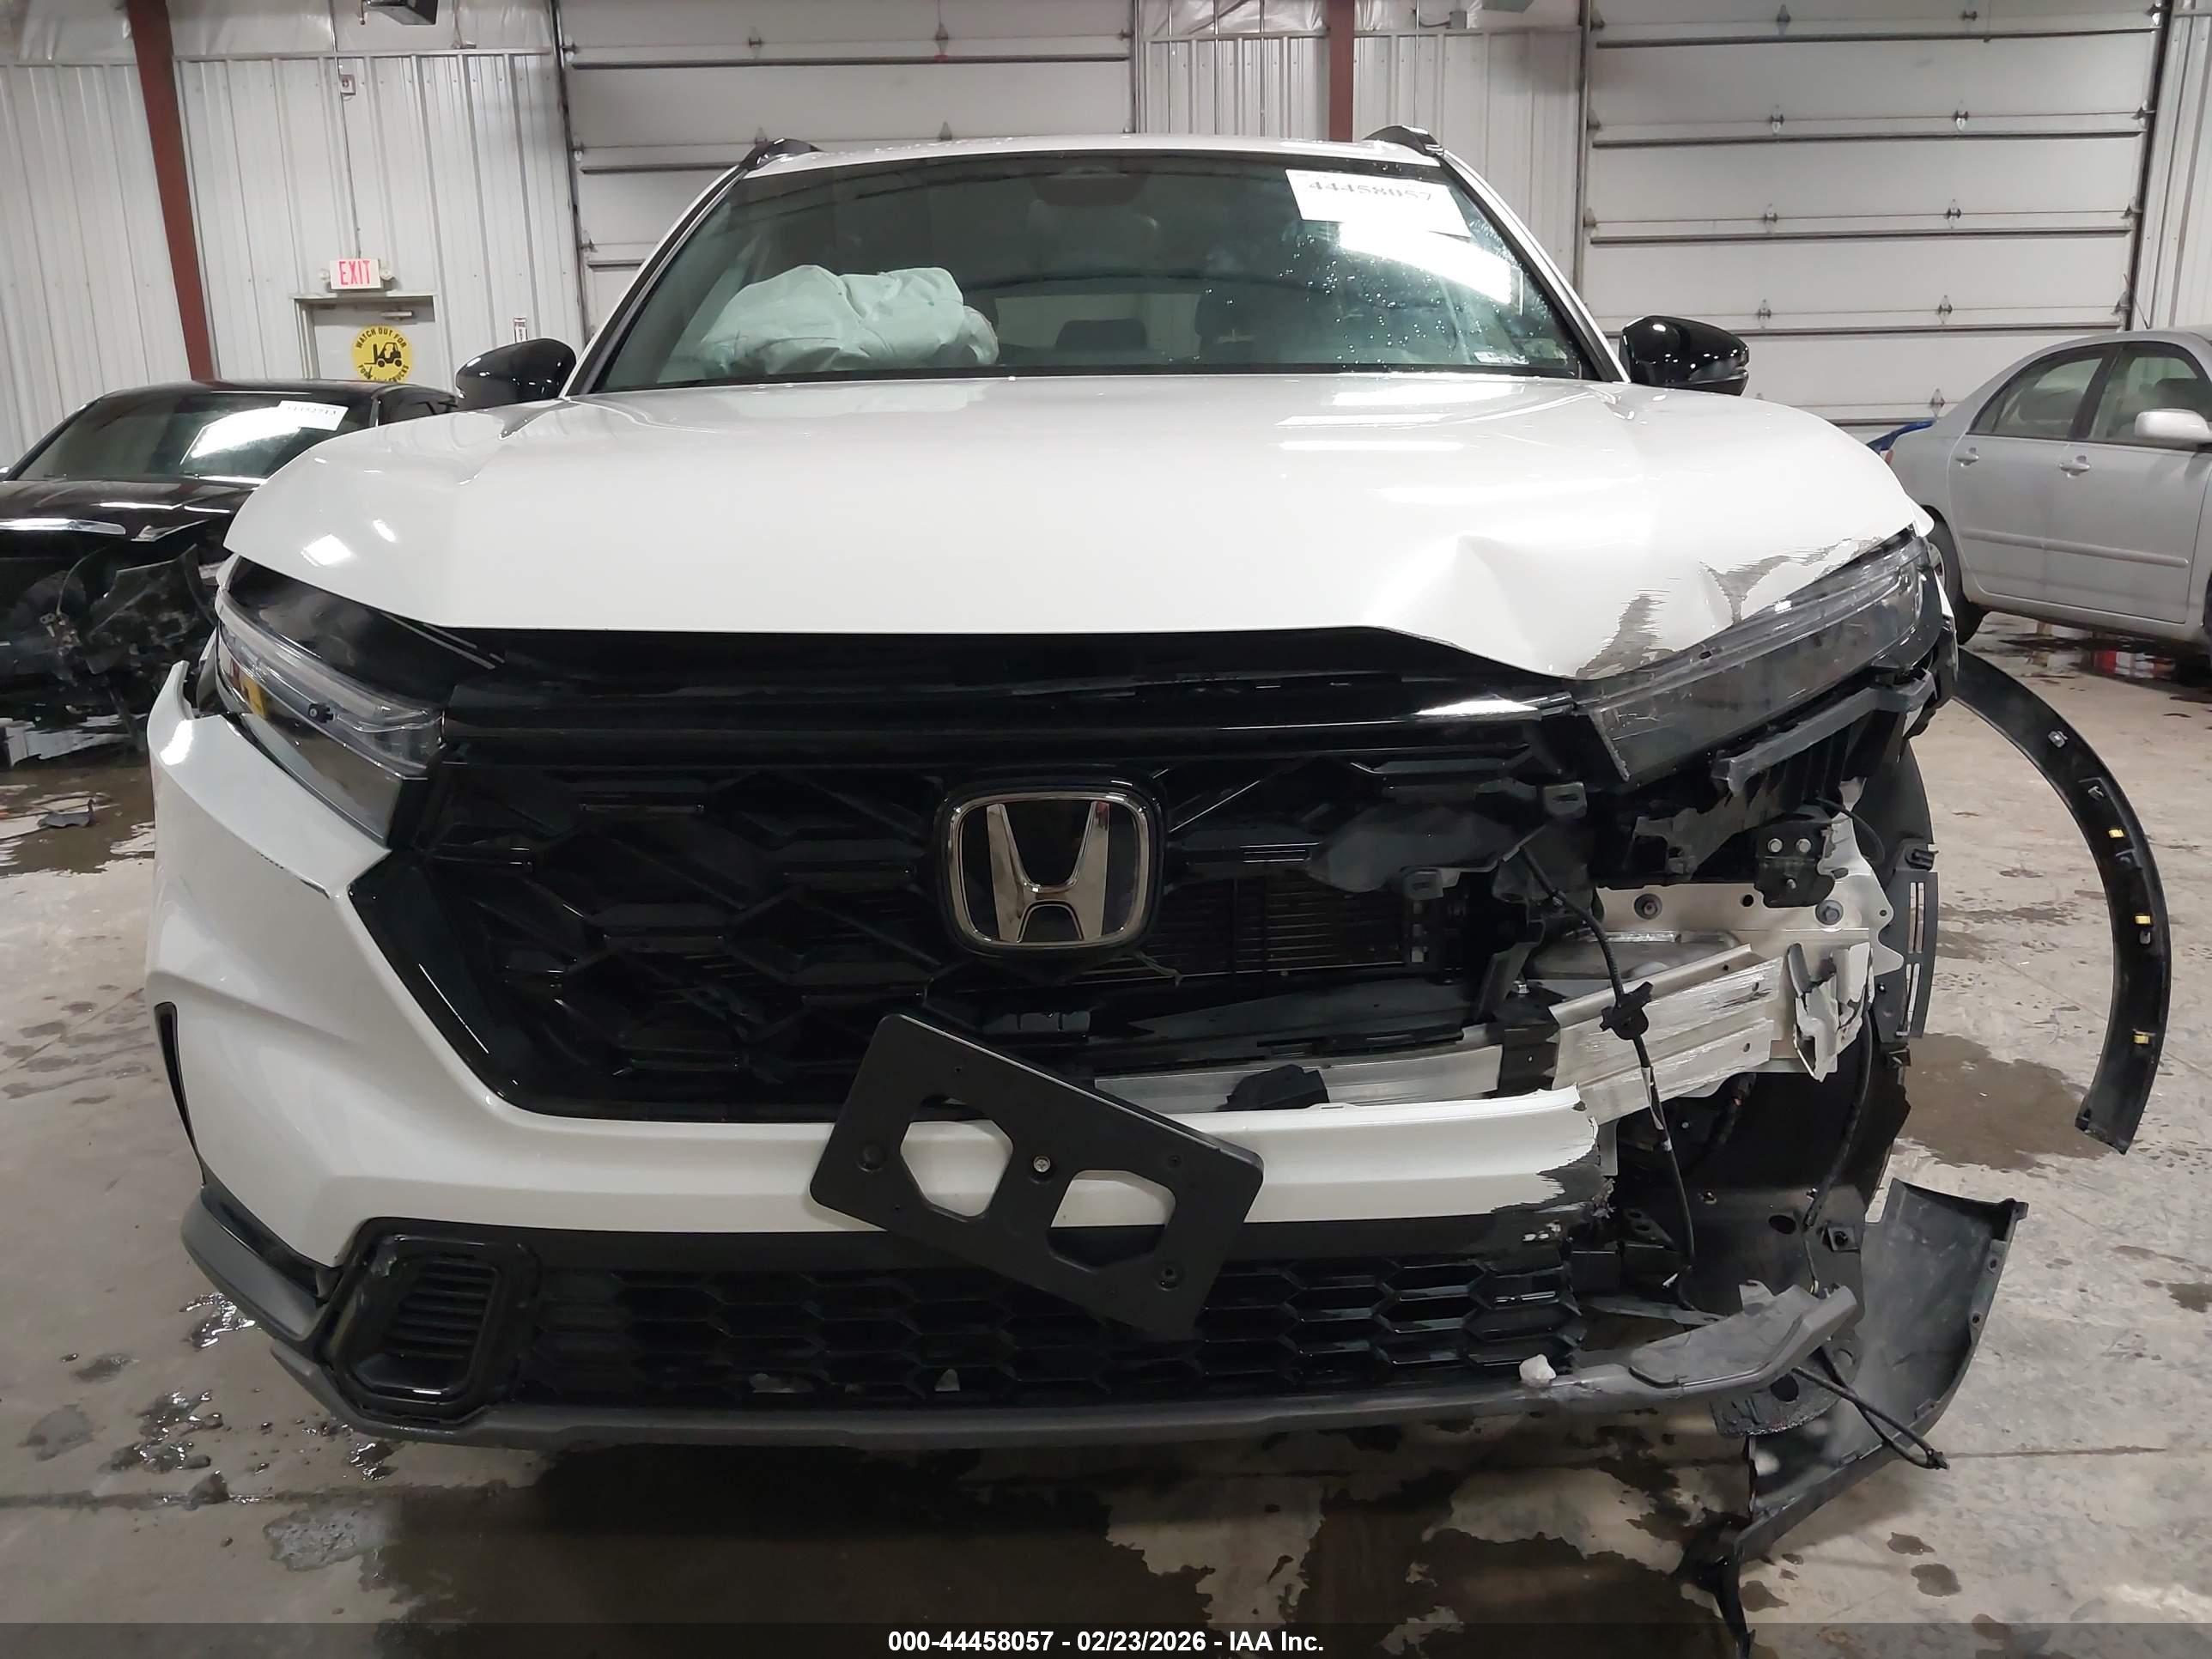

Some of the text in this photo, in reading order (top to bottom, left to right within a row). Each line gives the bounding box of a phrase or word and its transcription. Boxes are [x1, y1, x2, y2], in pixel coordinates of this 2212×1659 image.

[338, 260, 371, 286] EXIT
[356, 326, 408, 349] WATCH OUT FOR
